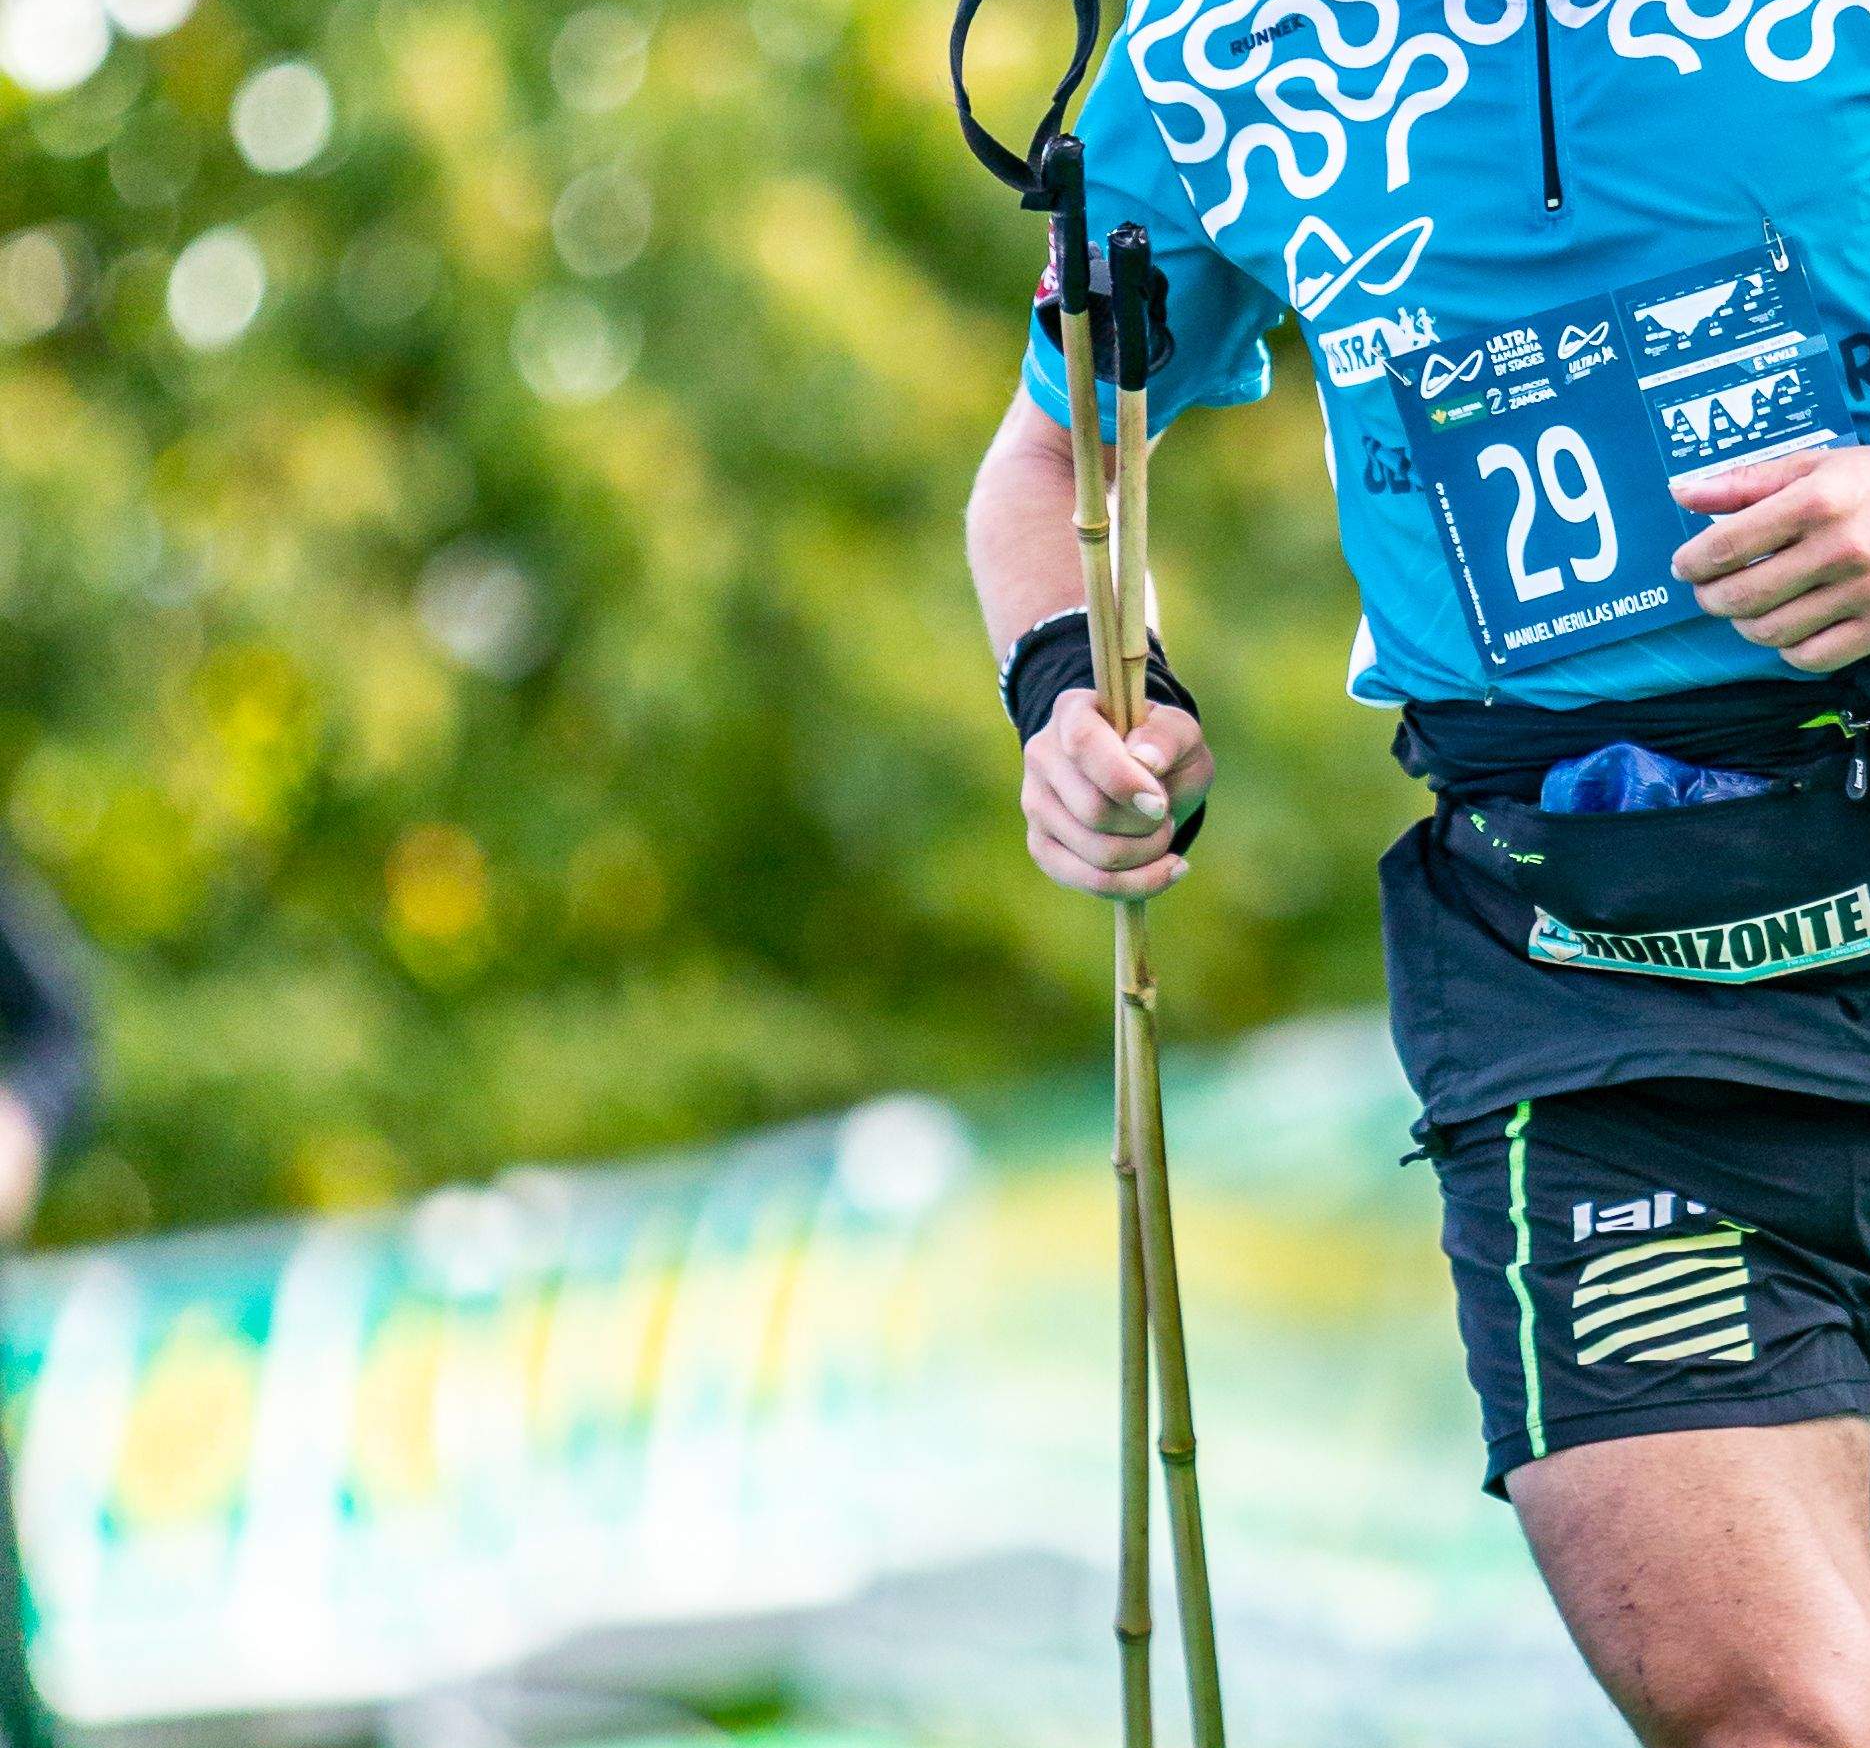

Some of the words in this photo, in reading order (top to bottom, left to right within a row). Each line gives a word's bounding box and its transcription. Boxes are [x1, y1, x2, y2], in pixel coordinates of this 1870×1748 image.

[1486, 327, 1538, 354] ULTRA
[1507, 352, 1545, 372] STAGES
[1568, 351, 1603, 374] ULTRA
[1478, 424, 1618, 603] 29
[1503, 621, 1555, 651] MANUEL
[1551, 603, 1614, 636] MERILLAS
[1611, 586, 1670, 619] MOLEDO
[1576, 892, 1869, 970] HORIZONTE
